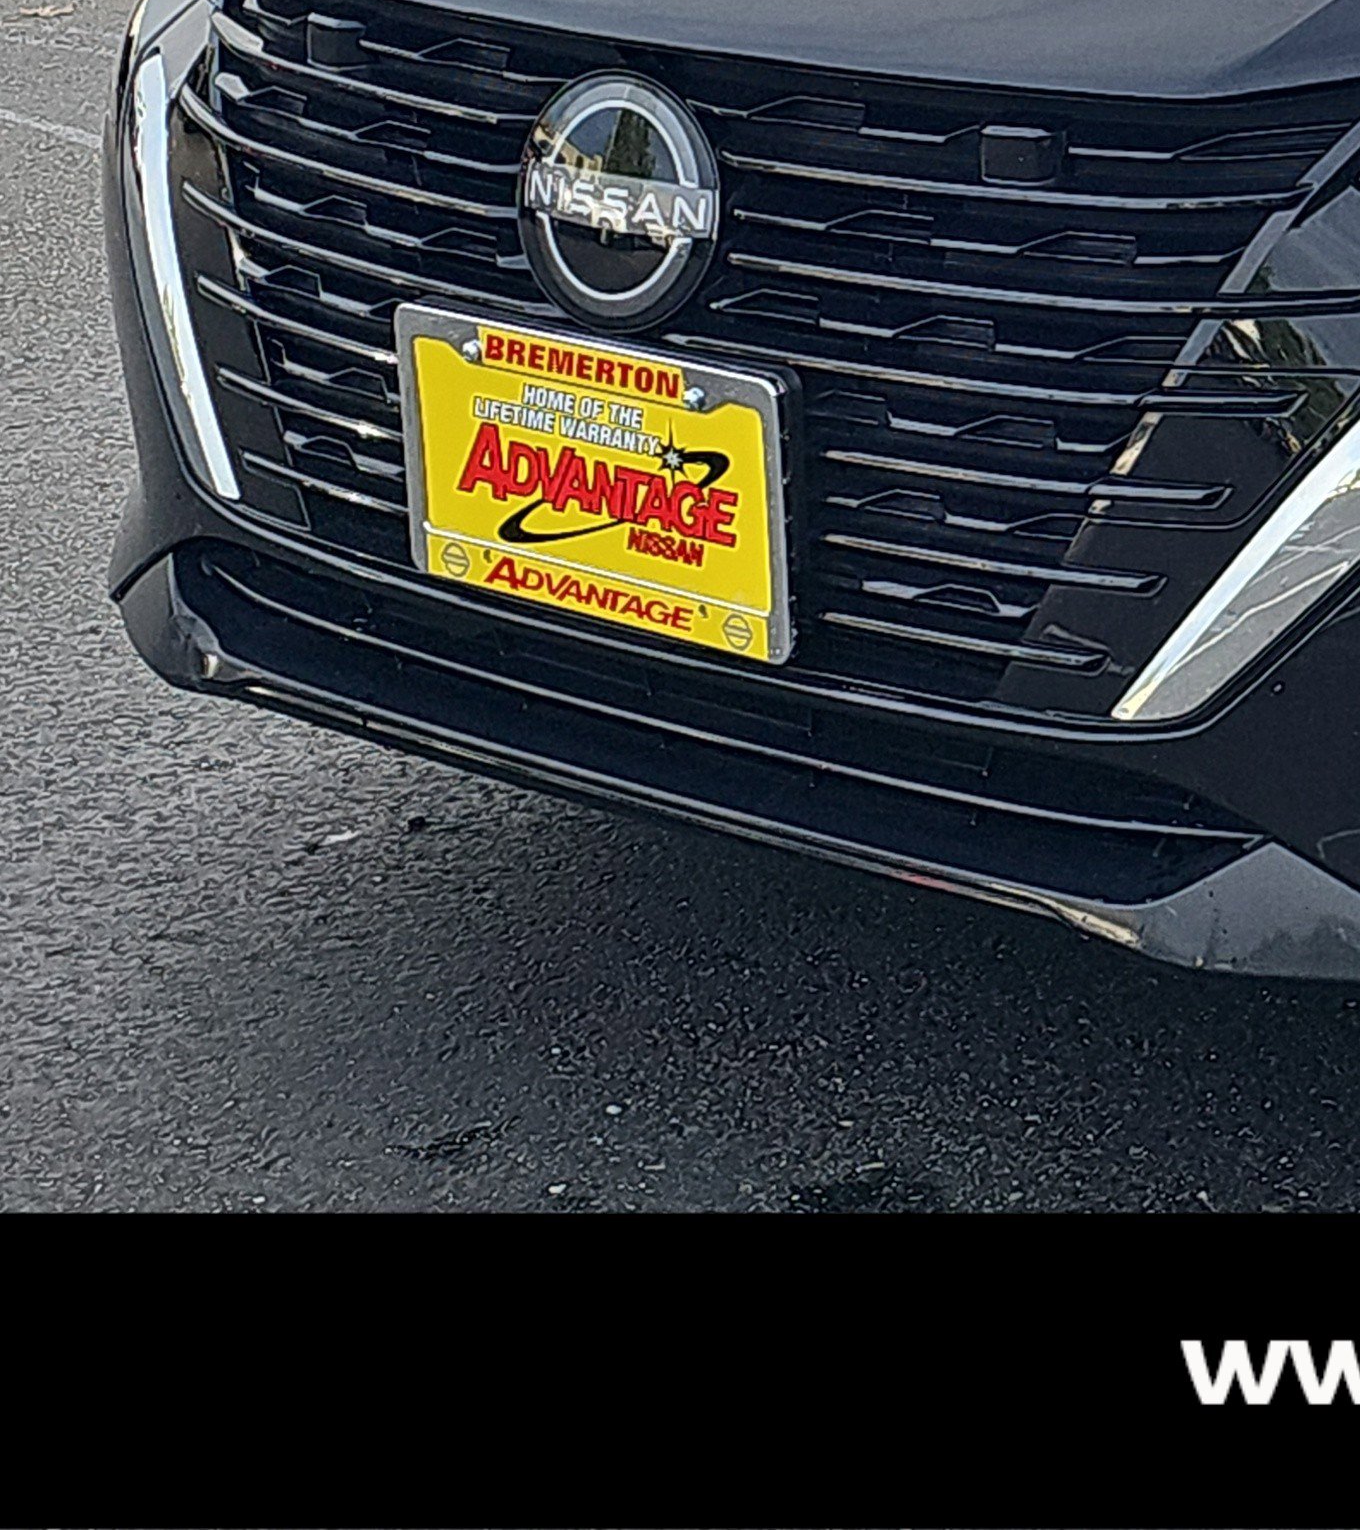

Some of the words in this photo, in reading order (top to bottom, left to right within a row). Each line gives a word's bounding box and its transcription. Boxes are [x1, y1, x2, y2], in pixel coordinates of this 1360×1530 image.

[529, 170, 706, 231] NISSAN
[485, 334, 680, 399] BREMERTON
[474, 396, 556, 432] LIFETIME
[560, 417, 660, 456] WARRANTY
[523, 383, 575, 414] HOME
[580, 396, 605, 419] OF
[609, 402, 643, 429] THE
[457, 422, 738, 548] ADVANTAGE
[626, 527, 705, 567] NISSAN
